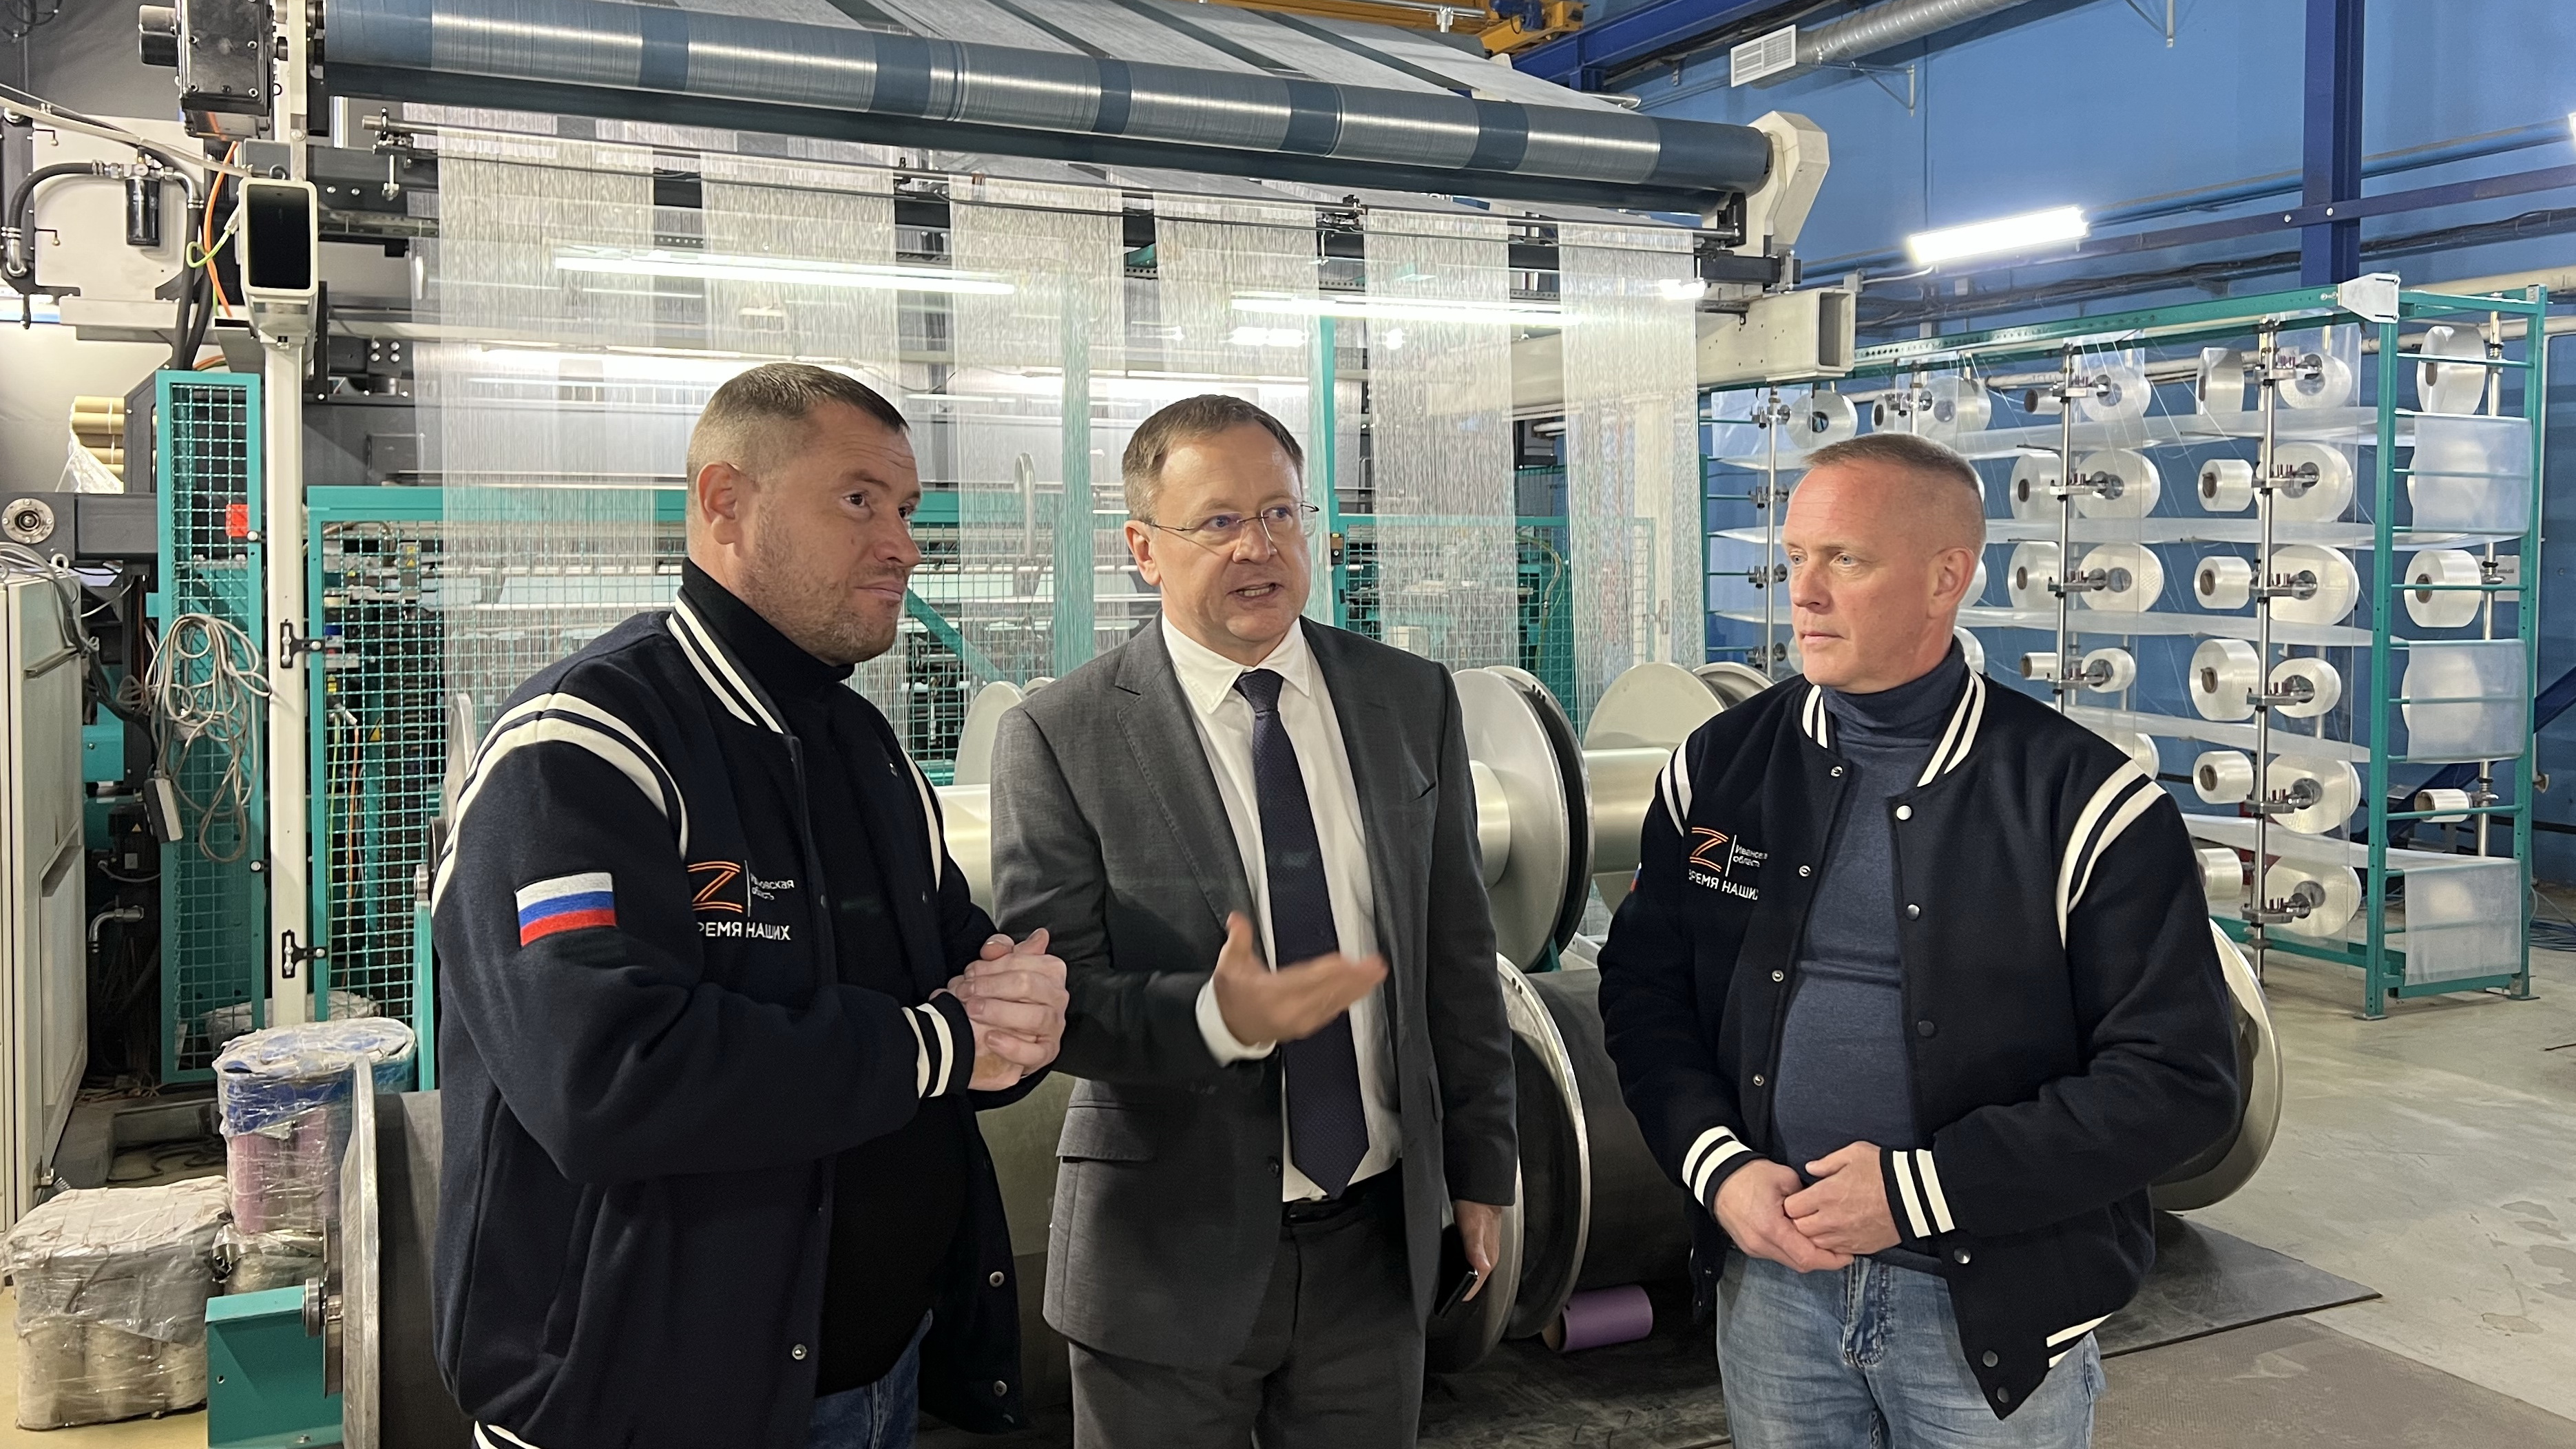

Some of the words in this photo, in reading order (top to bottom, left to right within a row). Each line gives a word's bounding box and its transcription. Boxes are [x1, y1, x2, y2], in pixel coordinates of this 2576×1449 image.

[1688, 868, 1720, 890] РЕМЯ
[697, 921, 742, 937] РЕМЯ
[745, 921, 791, 941] НАШИХ
